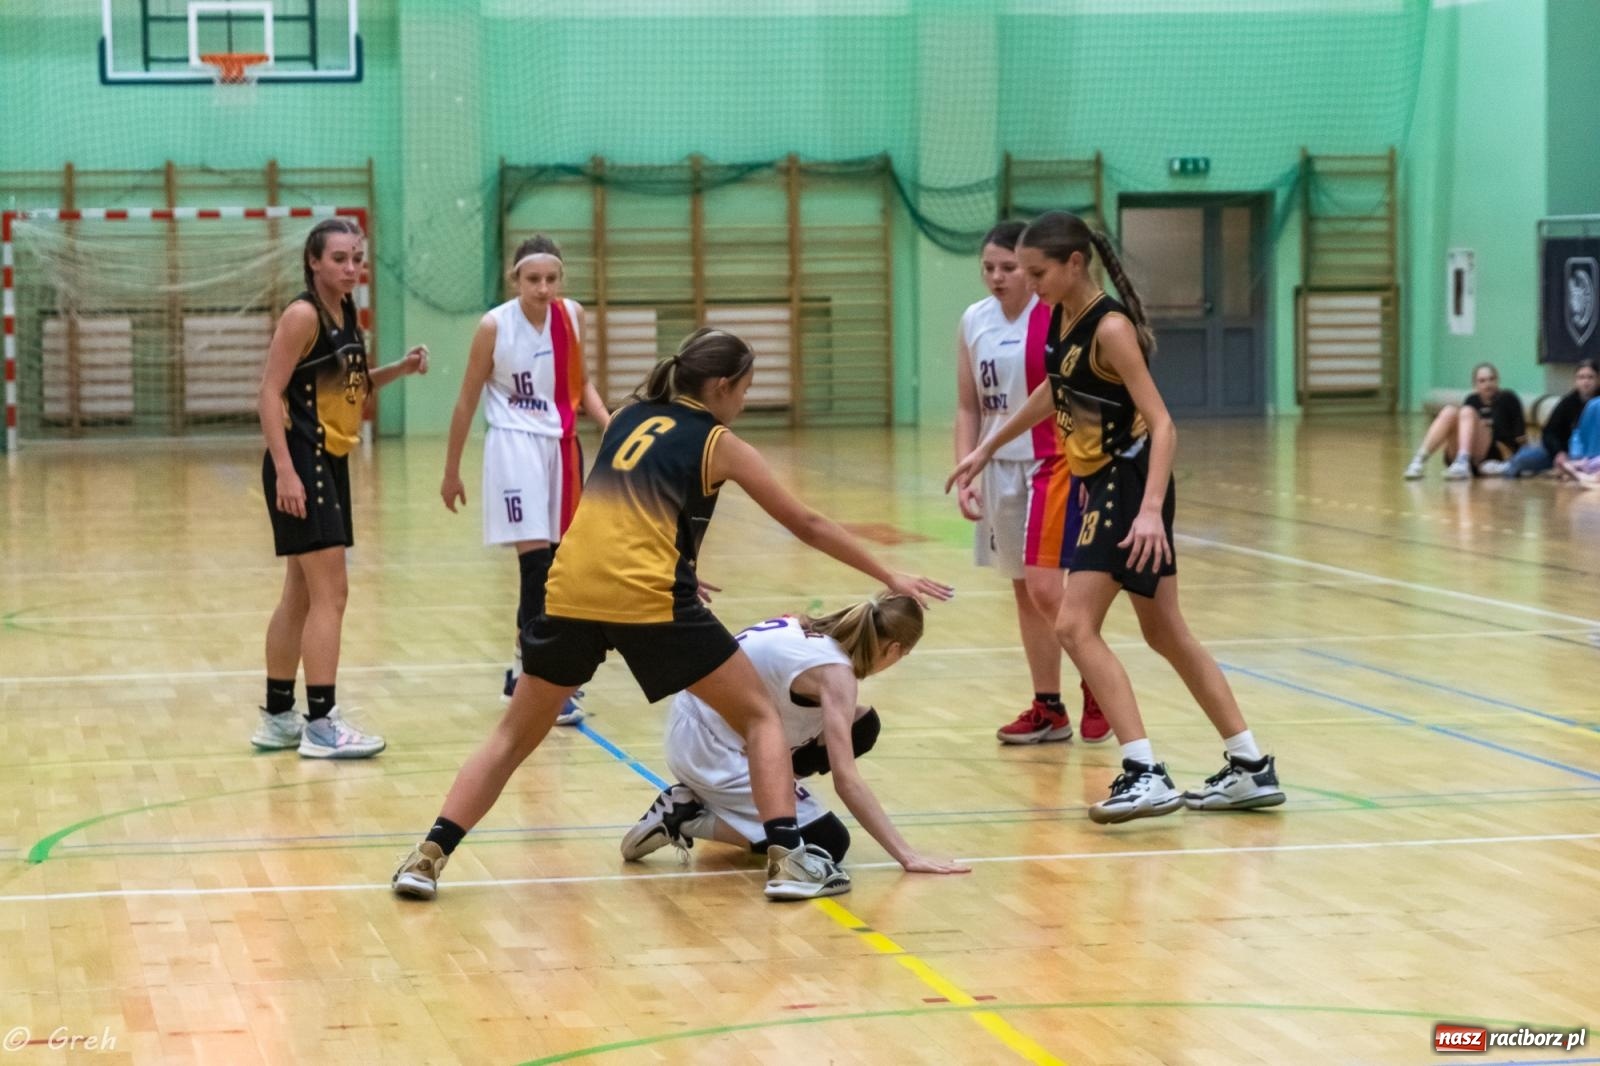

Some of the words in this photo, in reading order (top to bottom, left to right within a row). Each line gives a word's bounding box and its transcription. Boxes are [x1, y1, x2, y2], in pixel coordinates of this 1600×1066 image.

[512, 371, 534, 397] 16
[980, 359, 999, 388] 21
[611, 415, 677, 471] 6
[504, 496, 523, 523] 16
[1076, 510, 1100, 547] 13
